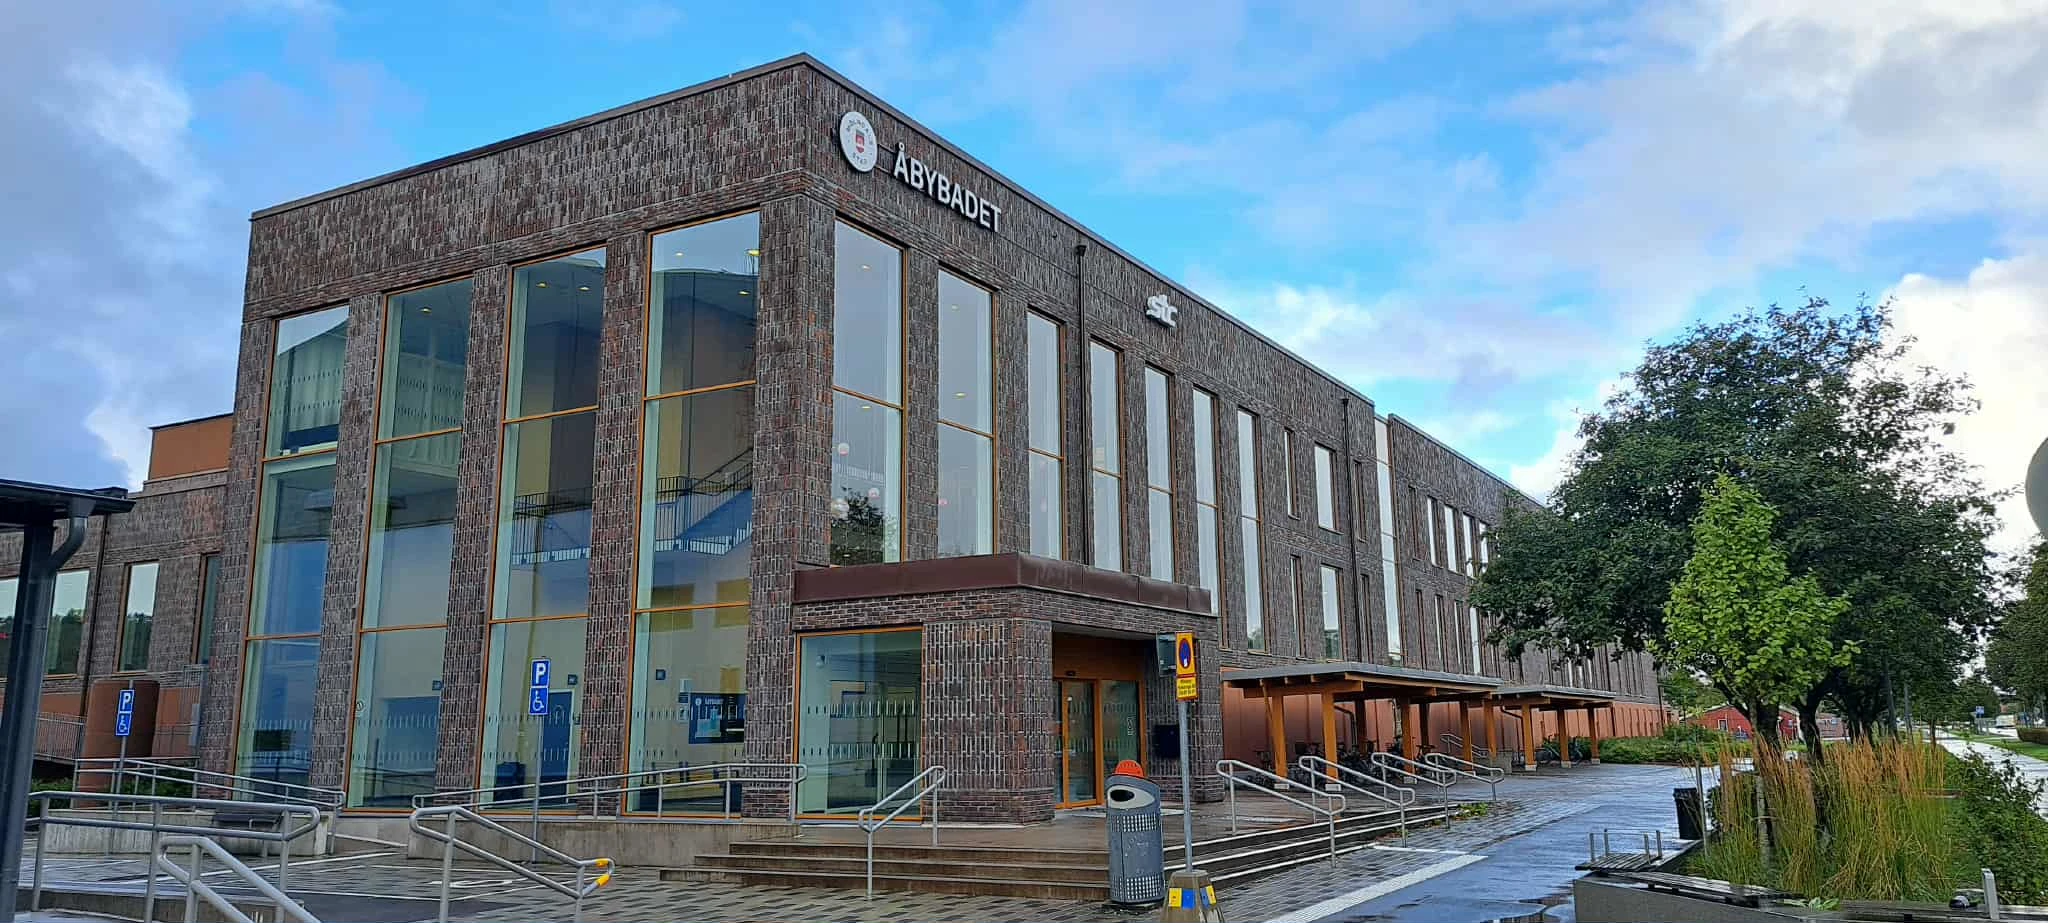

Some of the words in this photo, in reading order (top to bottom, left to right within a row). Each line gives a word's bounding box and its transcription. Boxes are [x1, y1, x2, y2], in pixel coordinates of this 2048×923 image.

[894, 142, 1001, 233] ÅBYBADET
[535, 662, 546, 684] P
[122, 692, 131, 710] P
